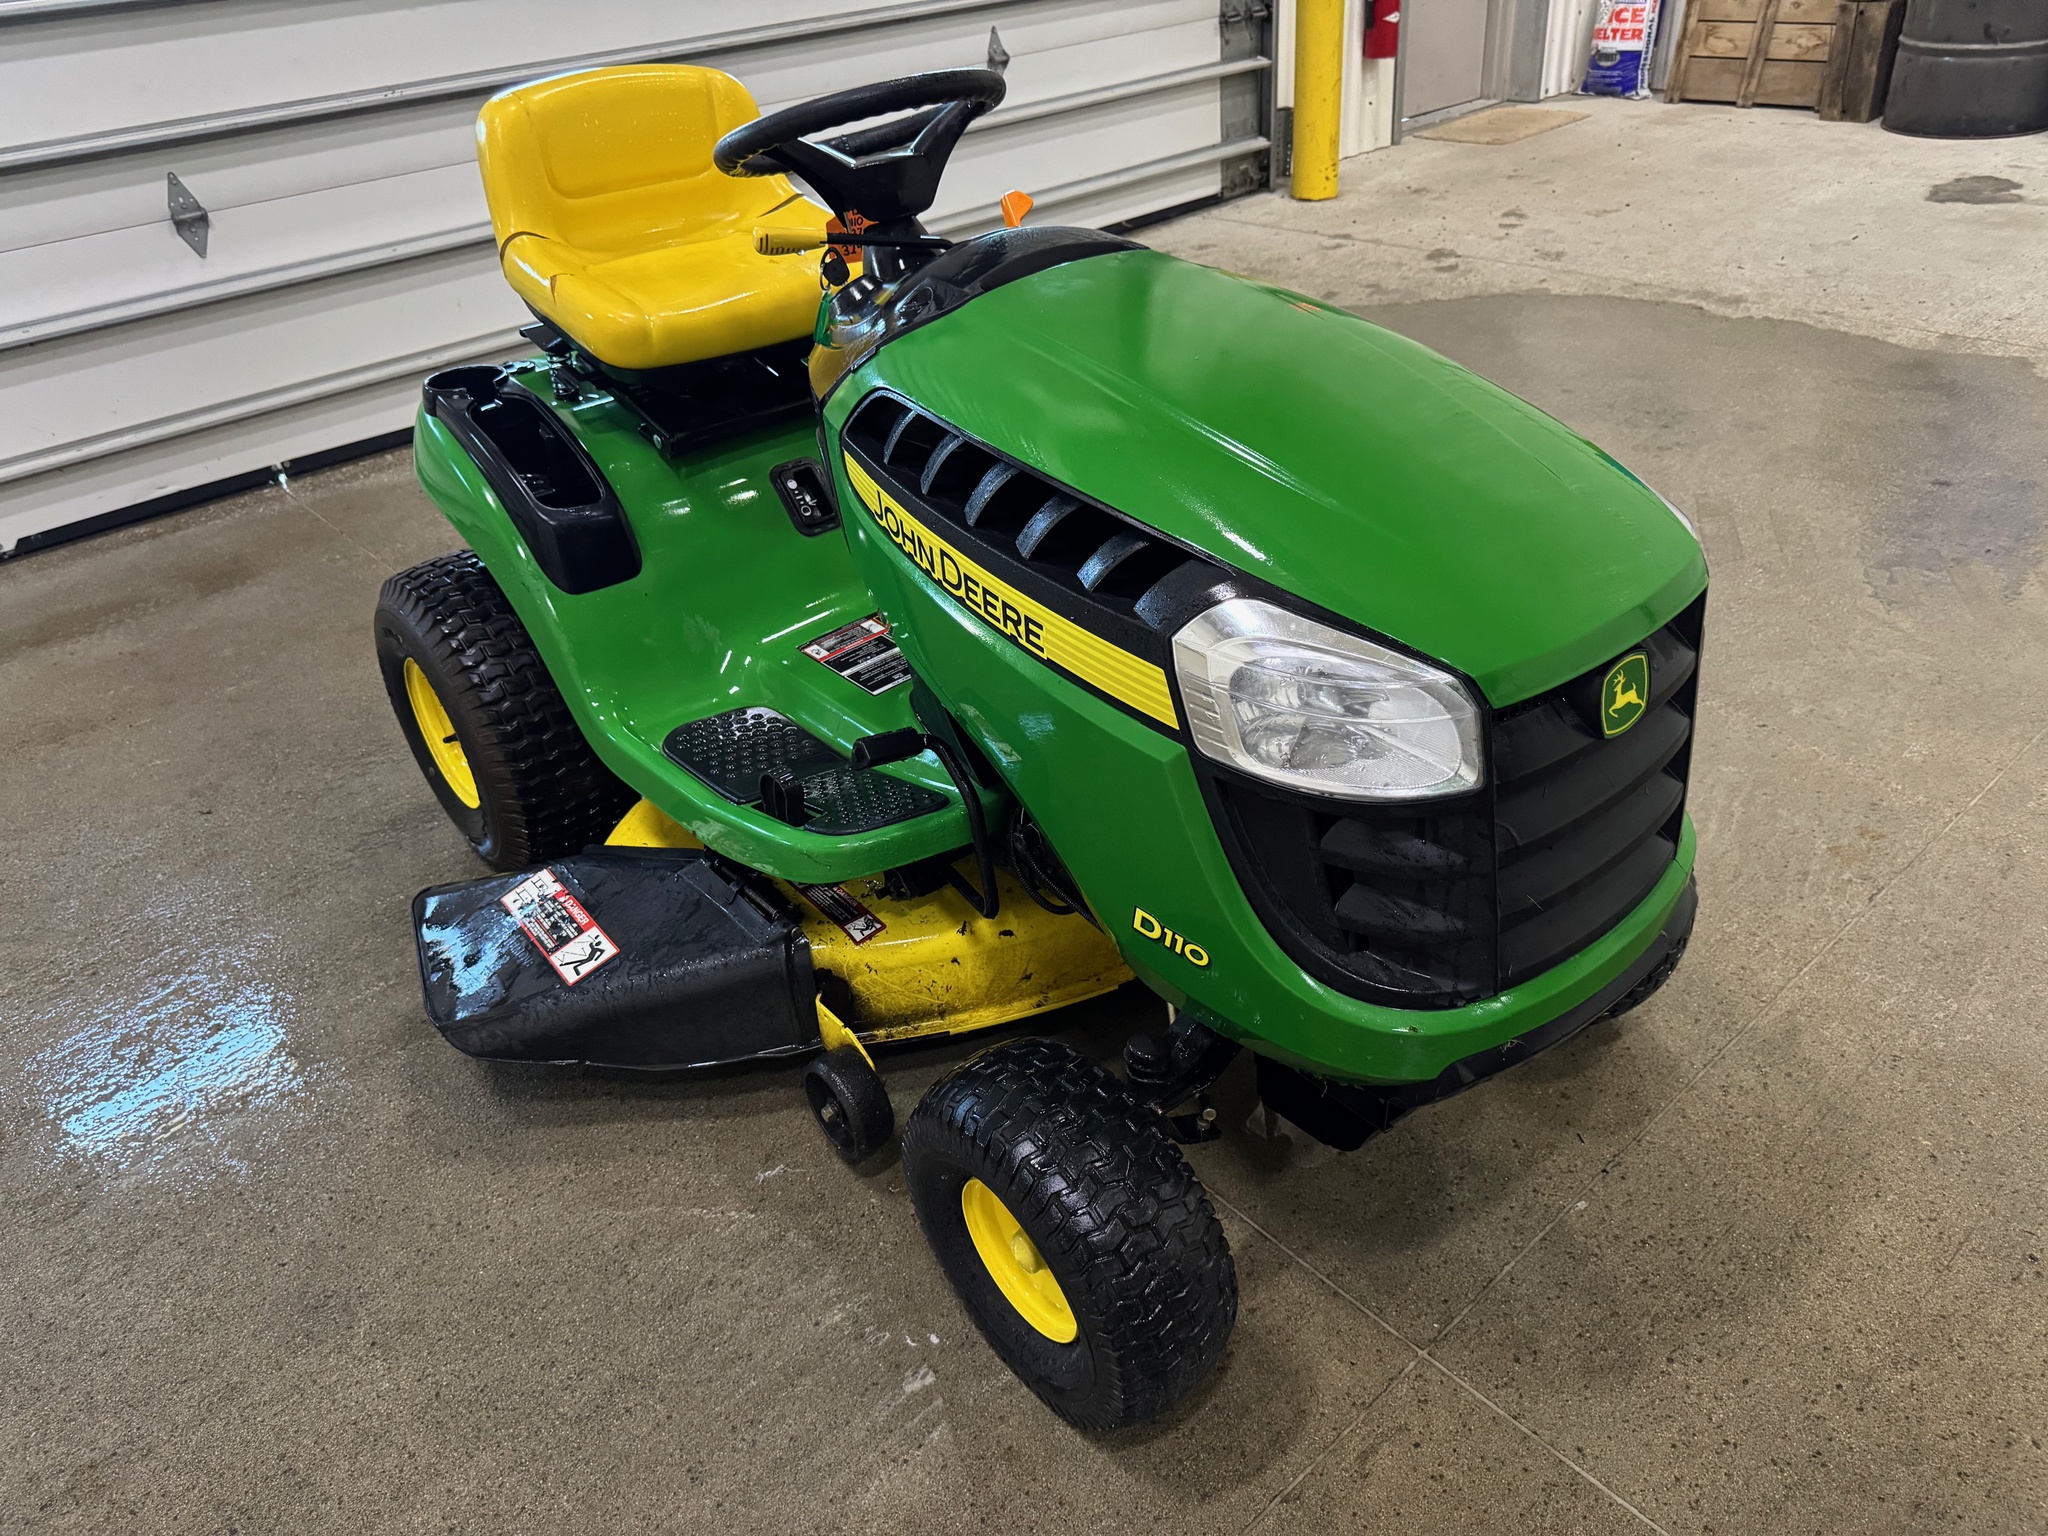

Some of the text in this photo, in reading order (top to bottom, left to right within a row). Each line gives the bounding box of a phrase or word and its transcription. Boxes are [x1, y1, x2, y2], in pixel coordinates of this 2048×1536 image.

[1607, 6, 1646, 24] ICE
[1593, 27, 1644, 41] ELTER
[874, 490, 1045, 654] JOHN DEERE
[565, 899, 590, 925] DANGER
[1133, 907, 1210, 967] D110
